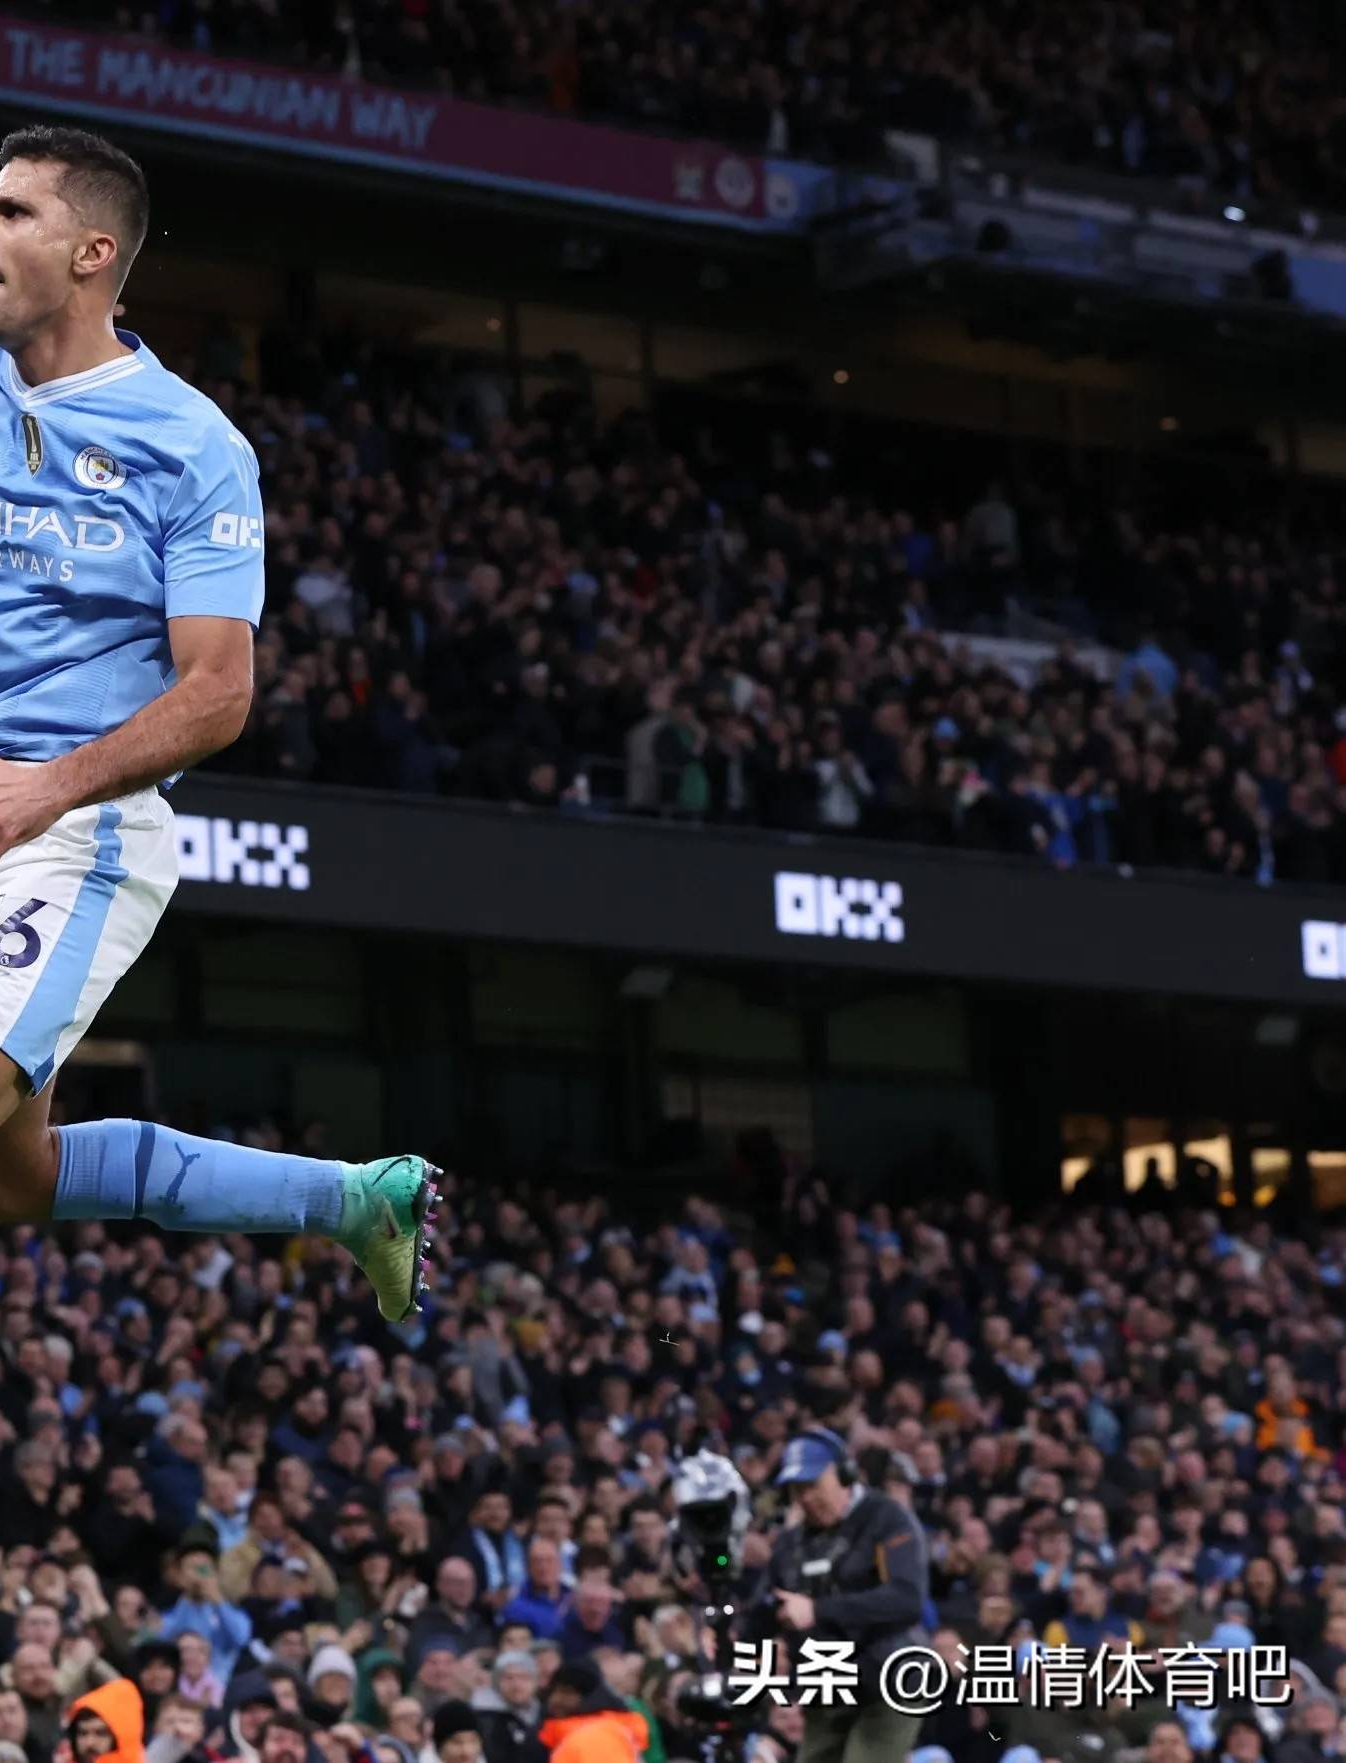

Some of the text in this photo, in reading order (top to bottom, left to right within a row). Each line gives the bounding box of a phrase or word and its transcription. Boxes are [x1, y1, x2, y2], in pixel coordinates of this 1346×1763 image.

[8, 29, 437, 148] THE MANCUNIAN WAY
[210, 511, 264, 548] OK
[173, 814, 310, 890] OKX
[775, 871, 904, 943] OKX
